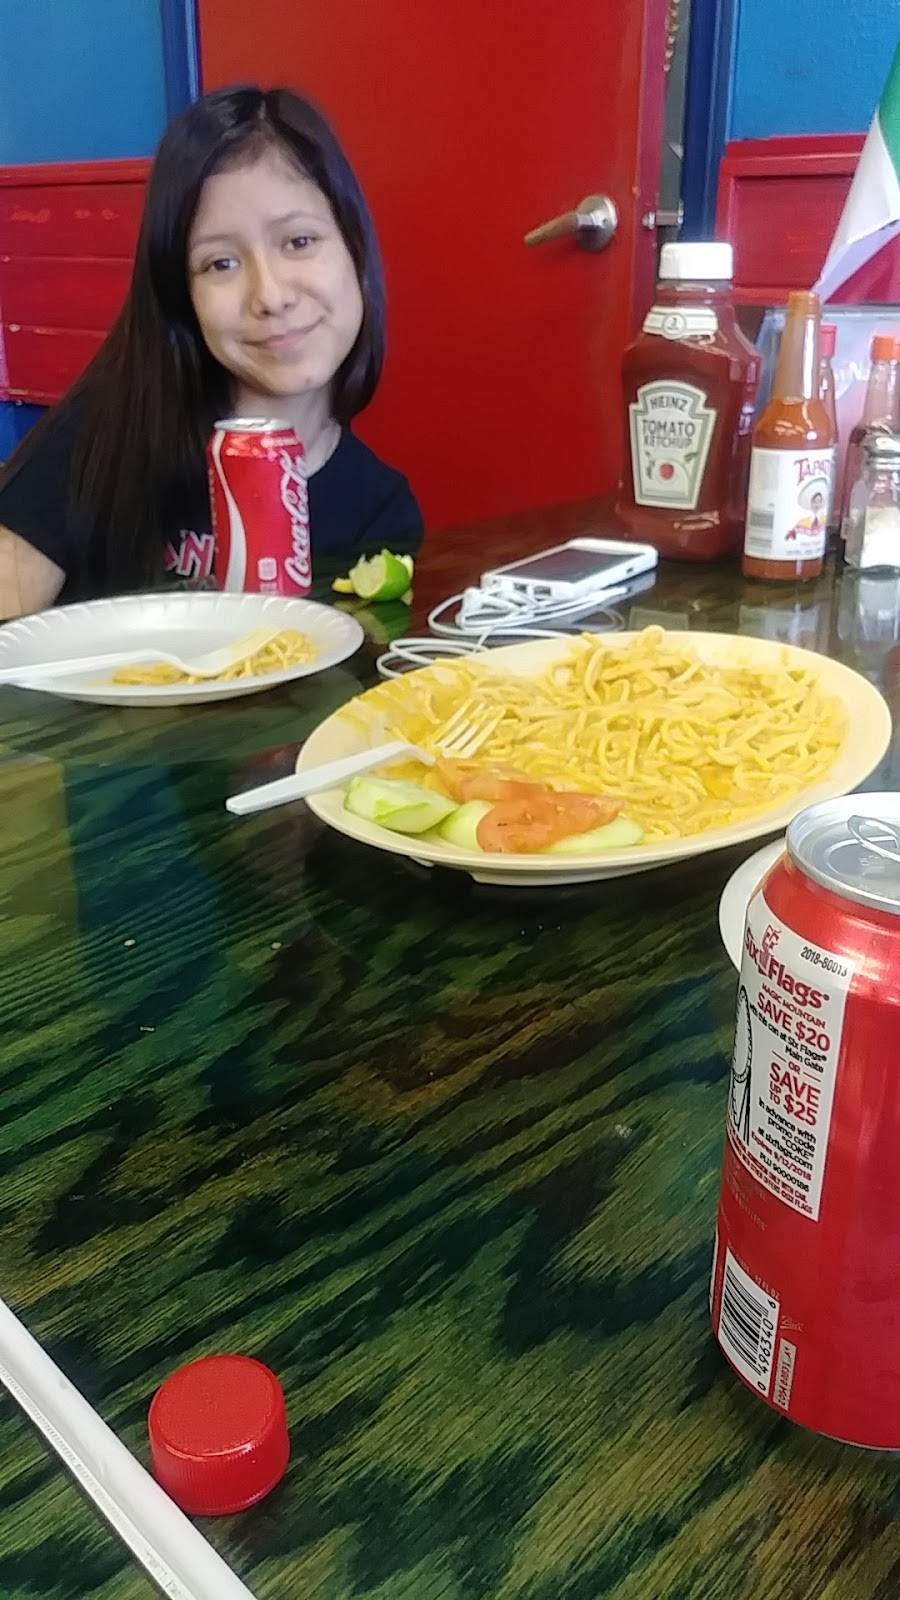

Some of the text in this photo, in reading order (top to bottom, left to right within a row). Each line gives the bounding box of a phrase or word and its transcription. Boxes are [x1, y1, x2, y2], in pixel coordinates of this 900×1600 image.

[649, 395, 688, 412] HEINZ
[642, 419, 697, 438] TOMATO
[643, 435, 693, 450] KETCHUP
[767, 956, 823, 1010] Flags
[757, 991, 831, 1052] SAVE $20
[782, 999, 827, 1029] MOUNTAIN
[788, 1036, 799, 1050] Six
[785, 1045, 824, 1074] Main Gate
[788, 1061, 801, 1075] OR
[769, 1062, 821, 1108] SAVE
[769, 1081, 782, 1094] UP
[769, 1090, 817, 1126] TO $25
[765, 1105, 796, 1132] advance
[797, 1128, 817, 1145] with
[767, 1116, 816, 1153] promo code
[760, 1151, 773, 1167] PLU
[765, 1133, 814, 1171] sixflags.com
[767, 1299, 777, 1309] 6
[757, 1317, 774, 1392] 0 496340
